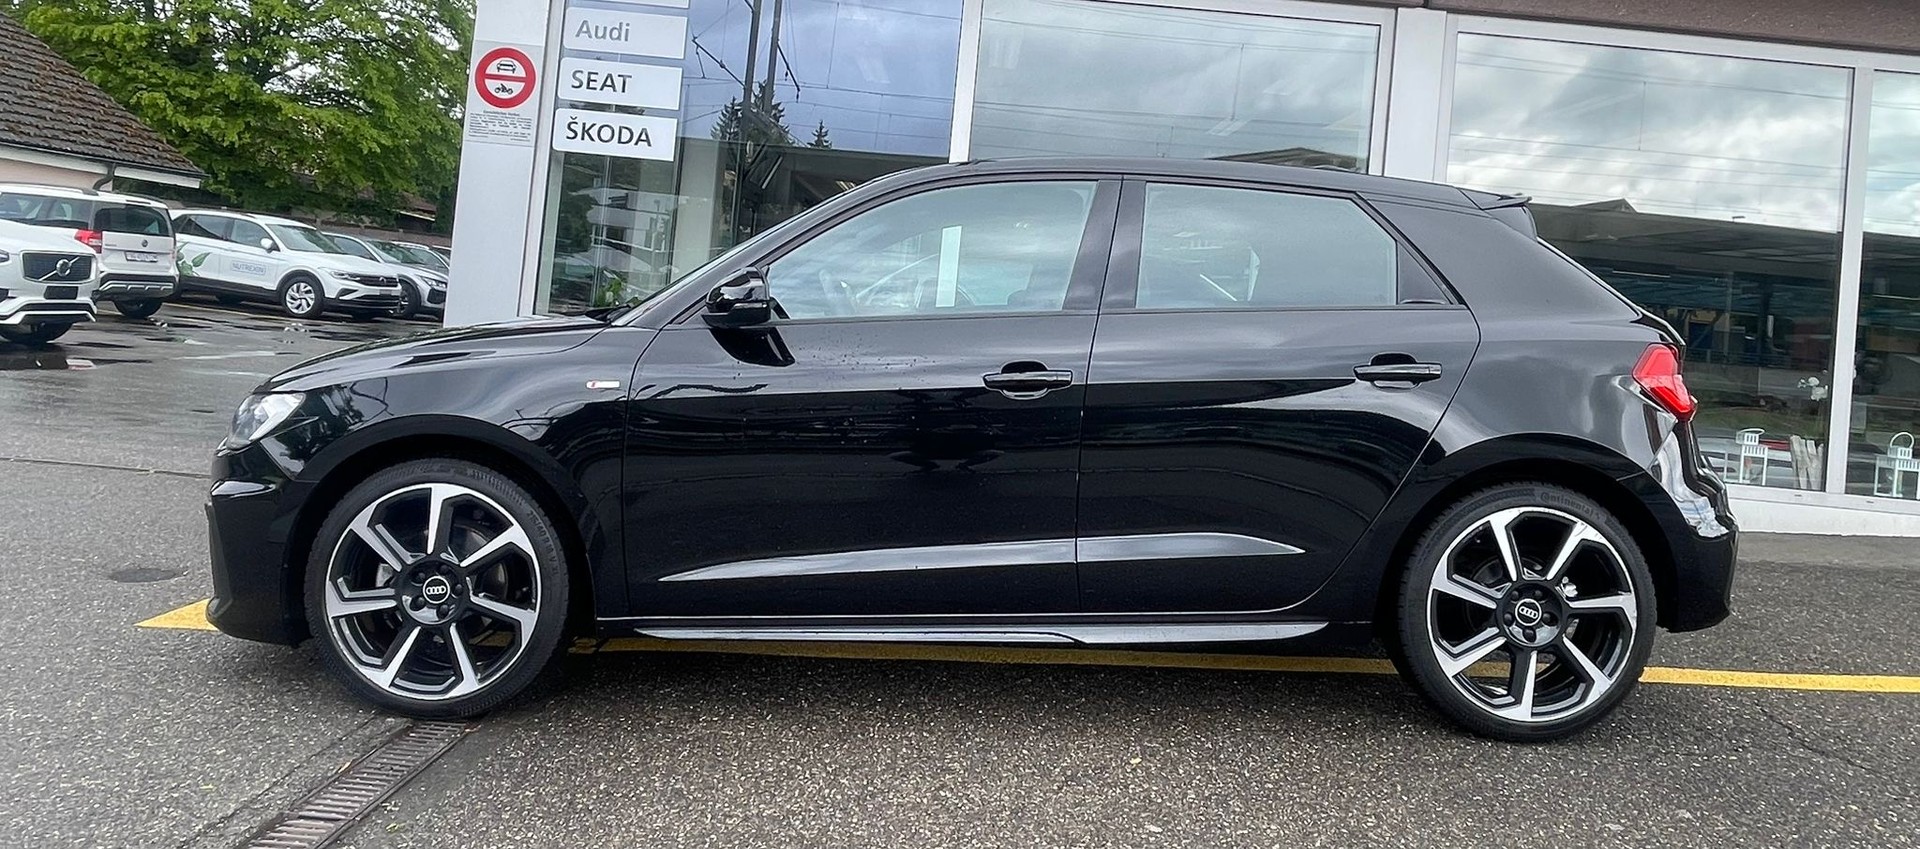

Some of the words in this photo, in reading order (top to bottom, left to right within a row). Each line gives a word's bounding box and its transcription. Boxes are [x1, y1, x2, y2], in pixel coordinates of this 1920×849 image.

[575, 20, 630, 42] Audi
[571, 70, 632, 93] SEAT
[566, 116, 652, 147] ŠKODA
